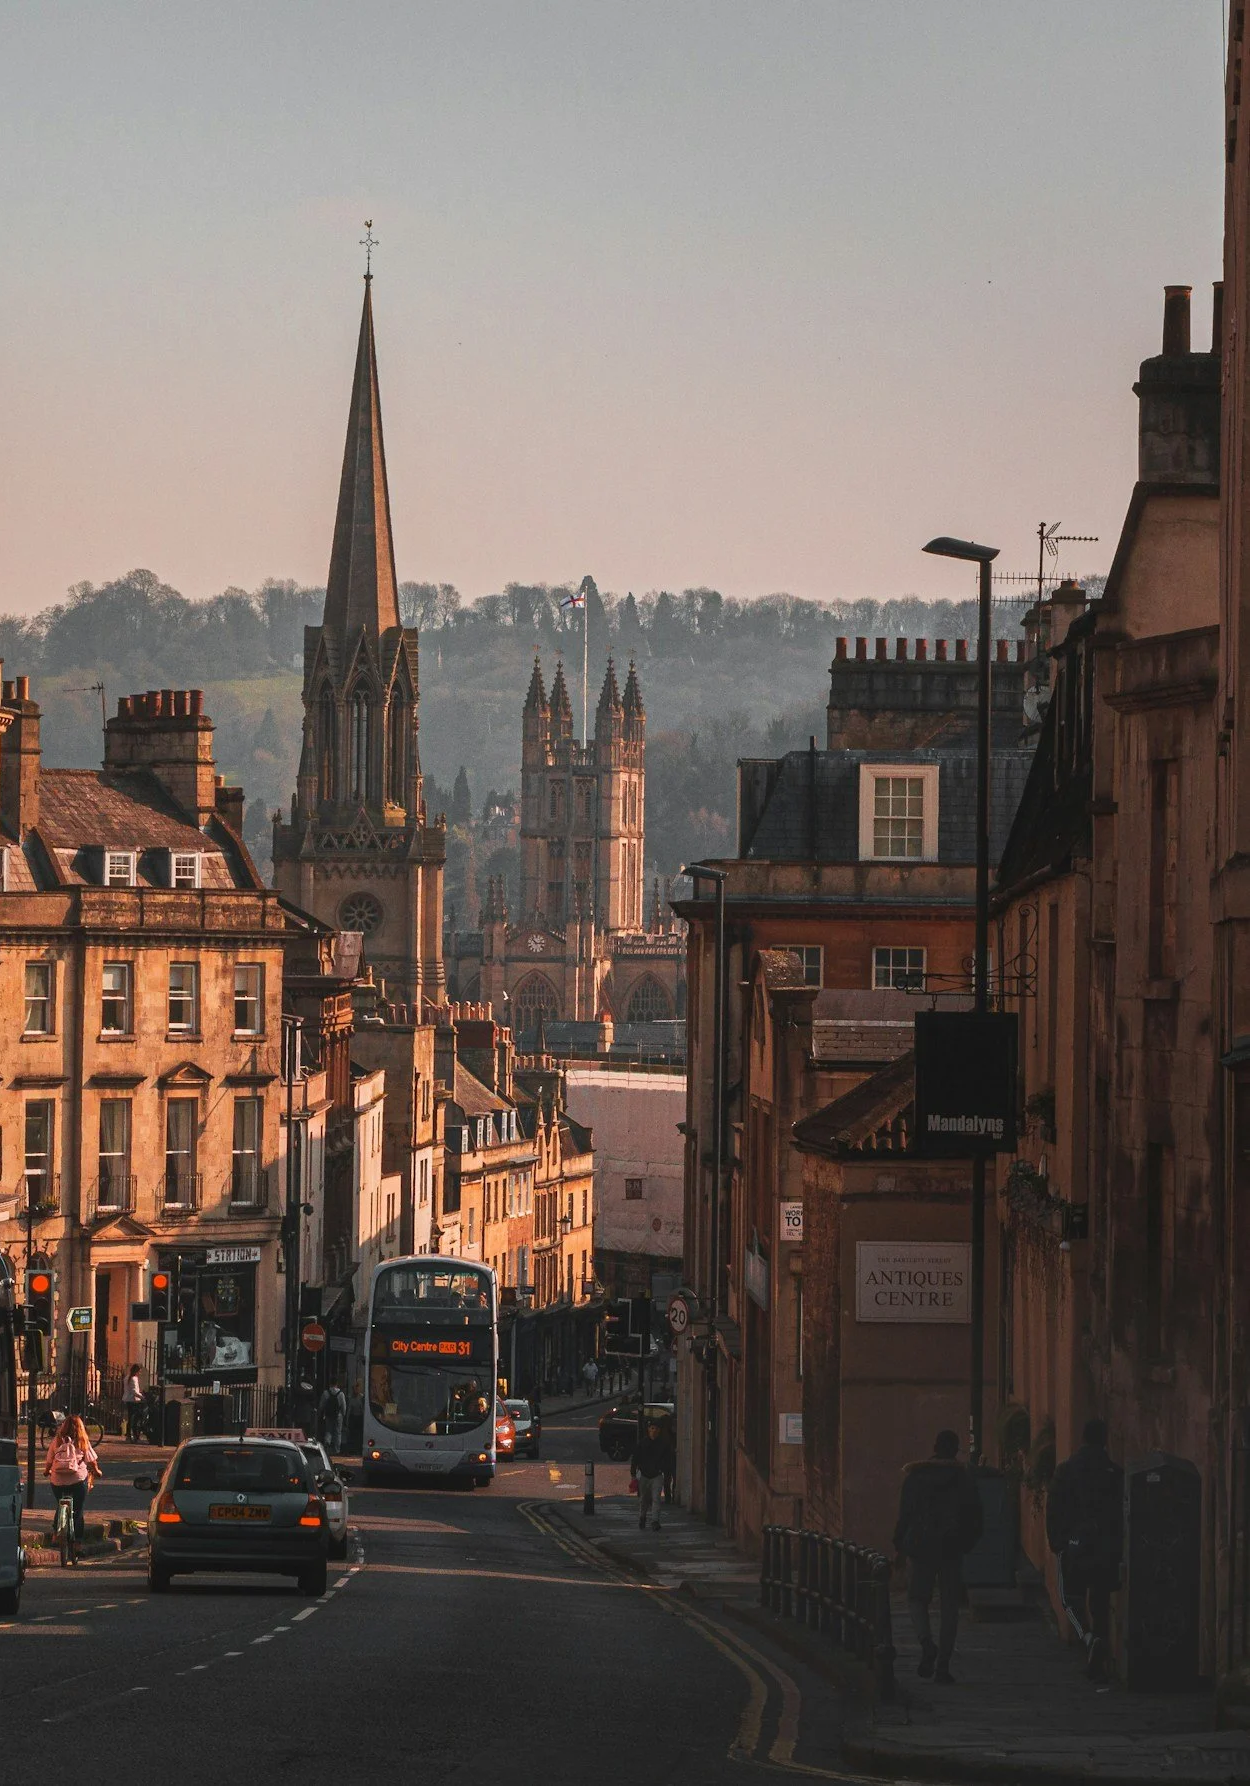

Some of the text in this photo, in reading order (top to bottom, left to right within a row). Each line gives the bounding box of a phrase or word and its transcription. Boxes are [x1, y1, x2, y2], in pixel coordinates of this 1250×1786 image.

[927, 1114, 1004, 1135] Mandalyns
[785, 1217, 801, 1226] TO
[865, 1271, 963, 1288] ANTIQUES
[874, 1291, 954, 1306] CENTRE
[671, 1307, 686, 1325] 20
[392, 1341, 409, 1353] City
[410, 1341, 438, 1352] Centre
[458, 1341, 470, 1355] 31
